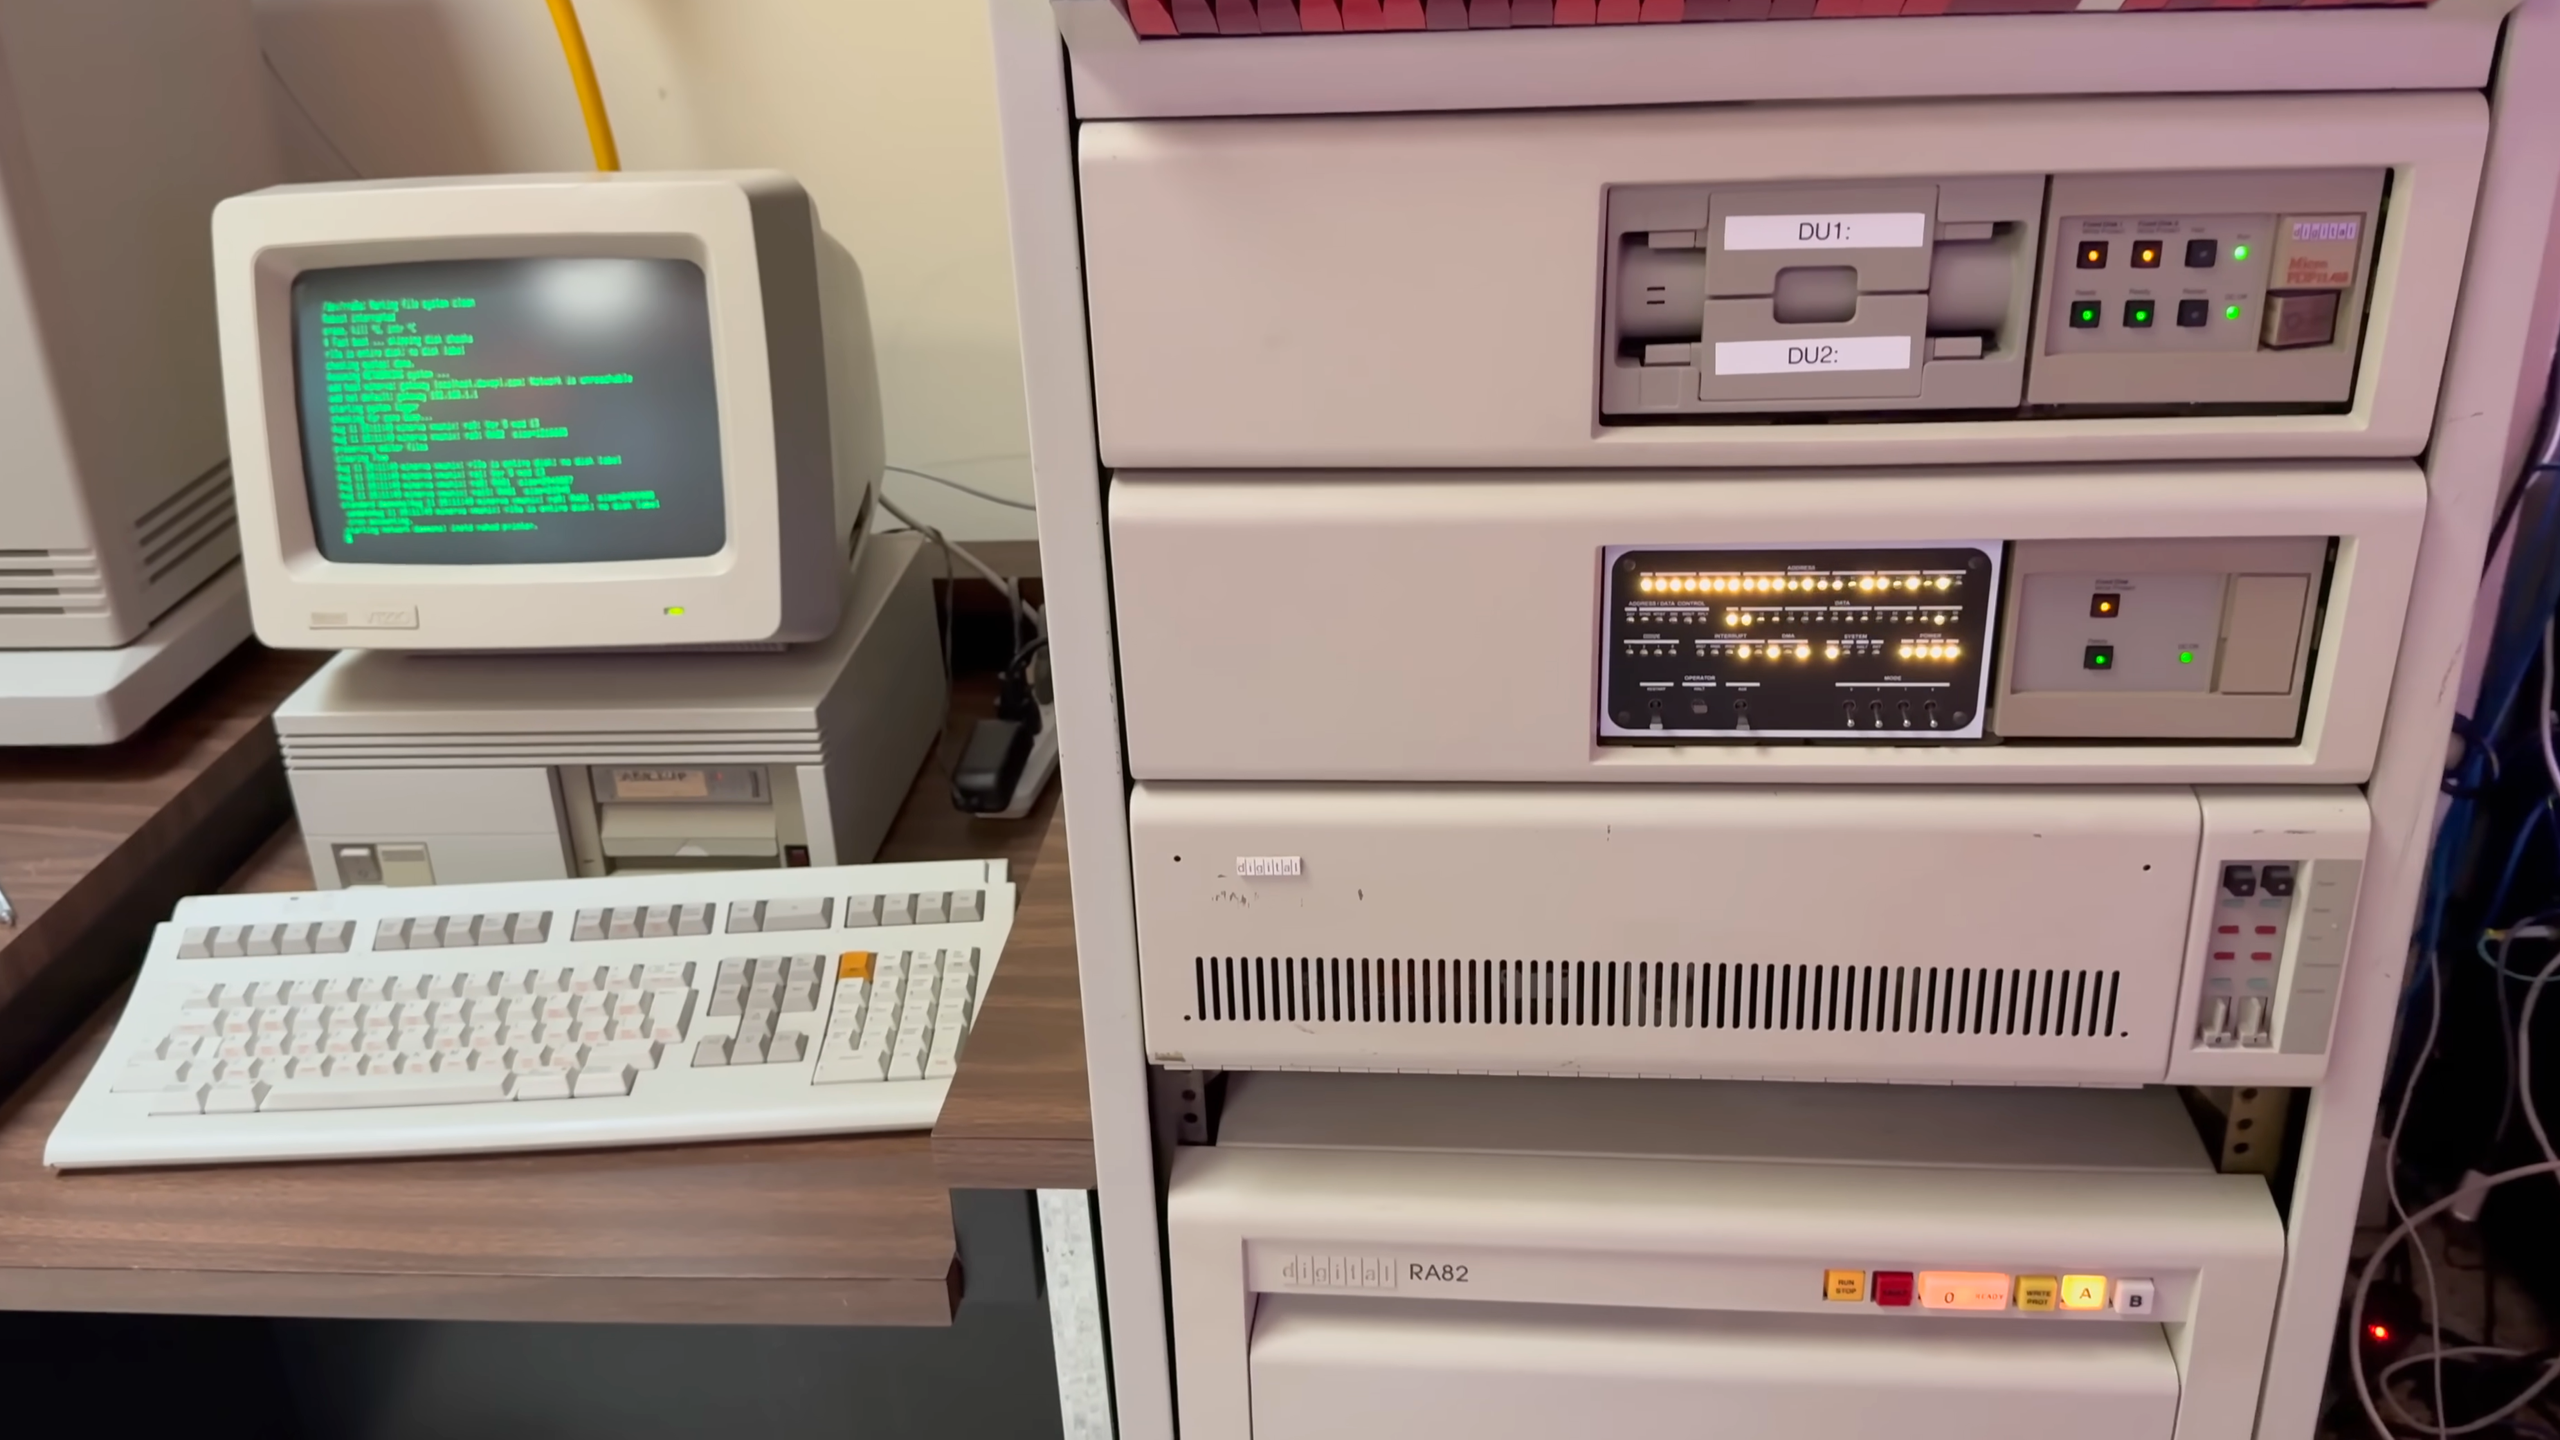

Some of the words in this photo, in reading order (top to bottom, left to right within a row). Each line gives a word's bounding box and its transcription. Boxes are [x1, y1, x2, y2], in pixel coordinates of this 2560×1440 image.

[1798, 222, 1851, 241] DU1:
[2293, 223, 2356, 239] digital
[1788, 346, 1839, 365] DU2:
[1237, 857, 1299, 875] digital
[1282, 1260, 1389, 1283] digital
[1409, 1263, 1469, 1282] RA82
[1836, 1287, 1857, 1295] STOP
[1944, 1291, 1954, 1304] 0
[2026, 1290, 2051, 1298] WRITE
[2080, 1287, 2092, 1300] A
[2130, 1295, 2143, 1308] B
